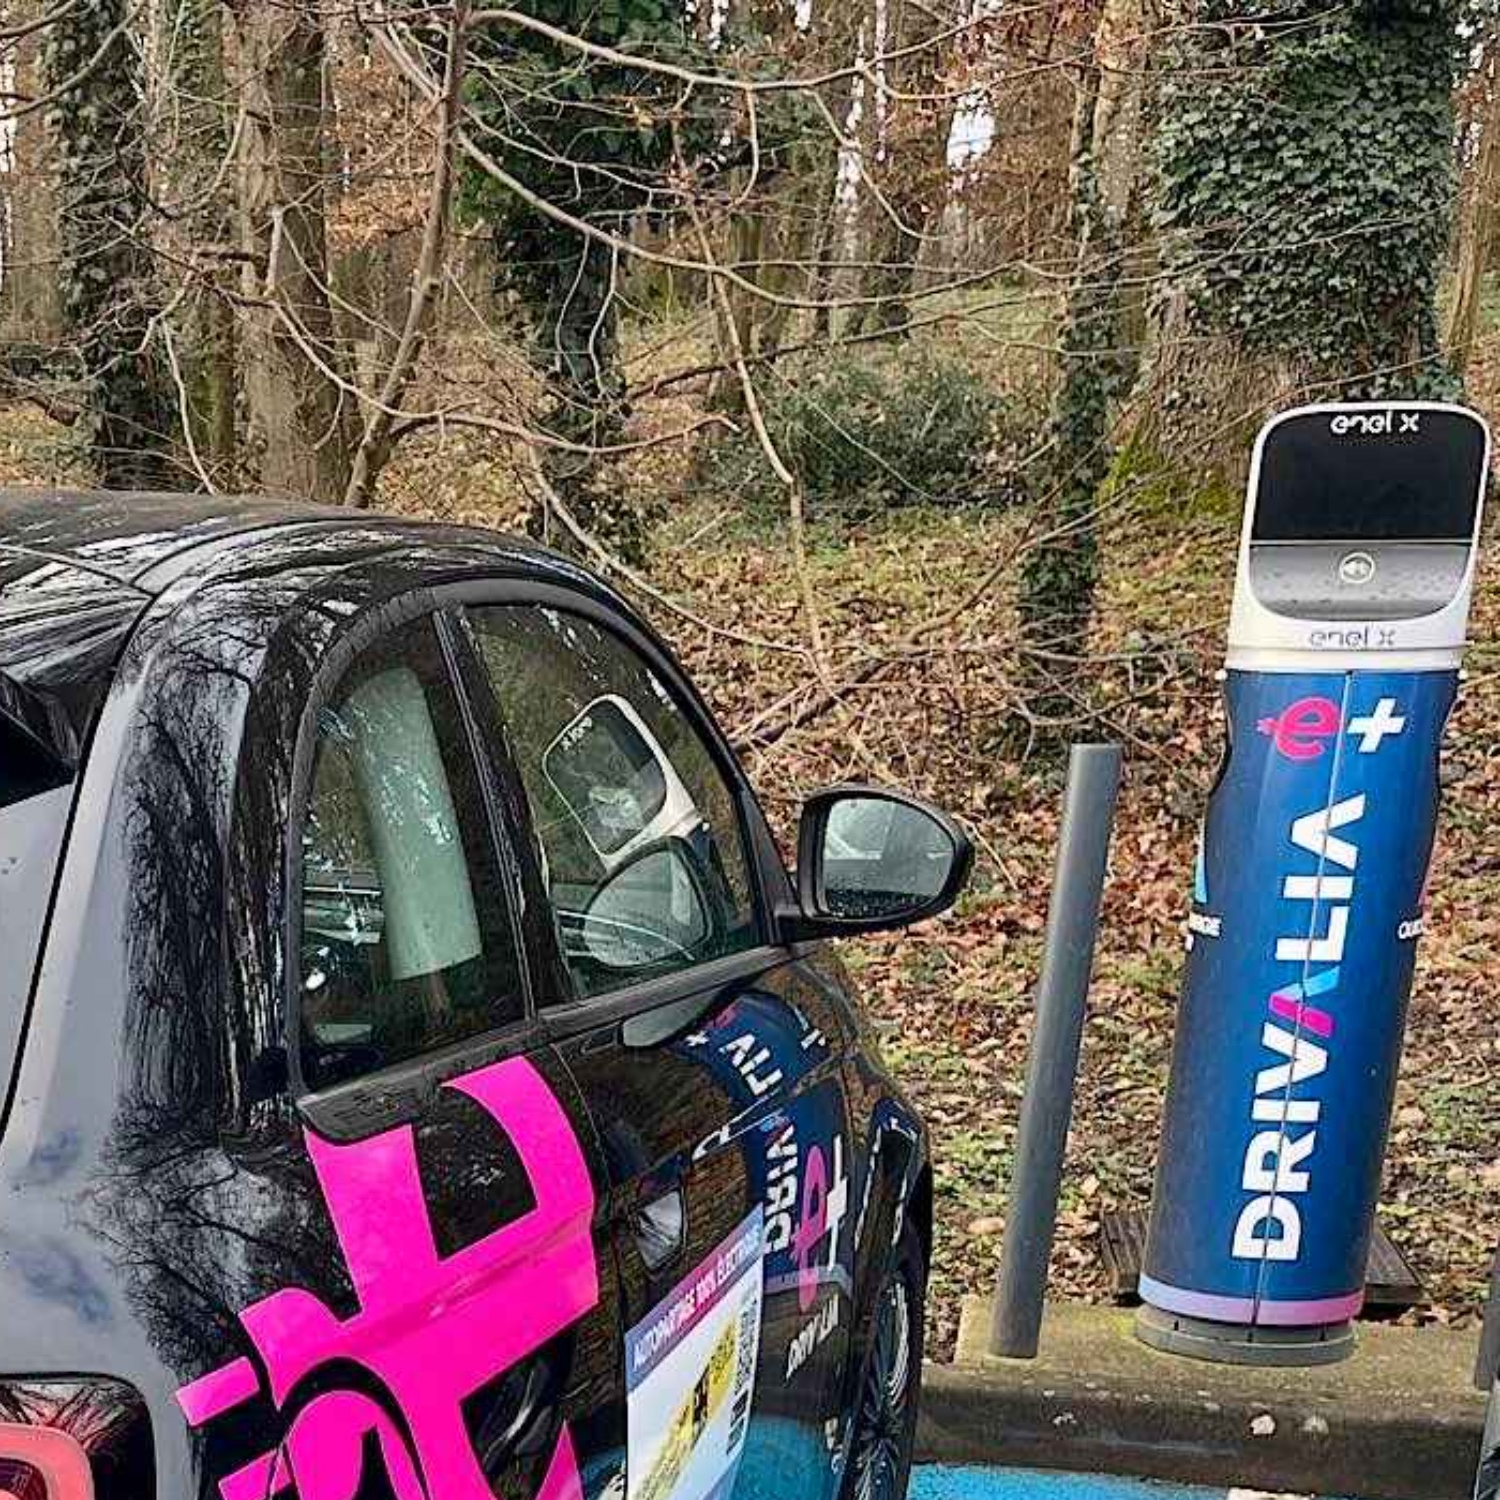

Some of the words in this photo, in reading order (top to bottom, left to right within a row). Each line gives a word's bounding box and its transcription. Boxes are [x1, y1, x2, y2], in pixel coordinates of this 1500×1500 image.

[1331, 411, 1392, 433] enel
[1308, 627, 1369, 648] enel
[1231, 793, 1366, 1262] DRIVALIA
